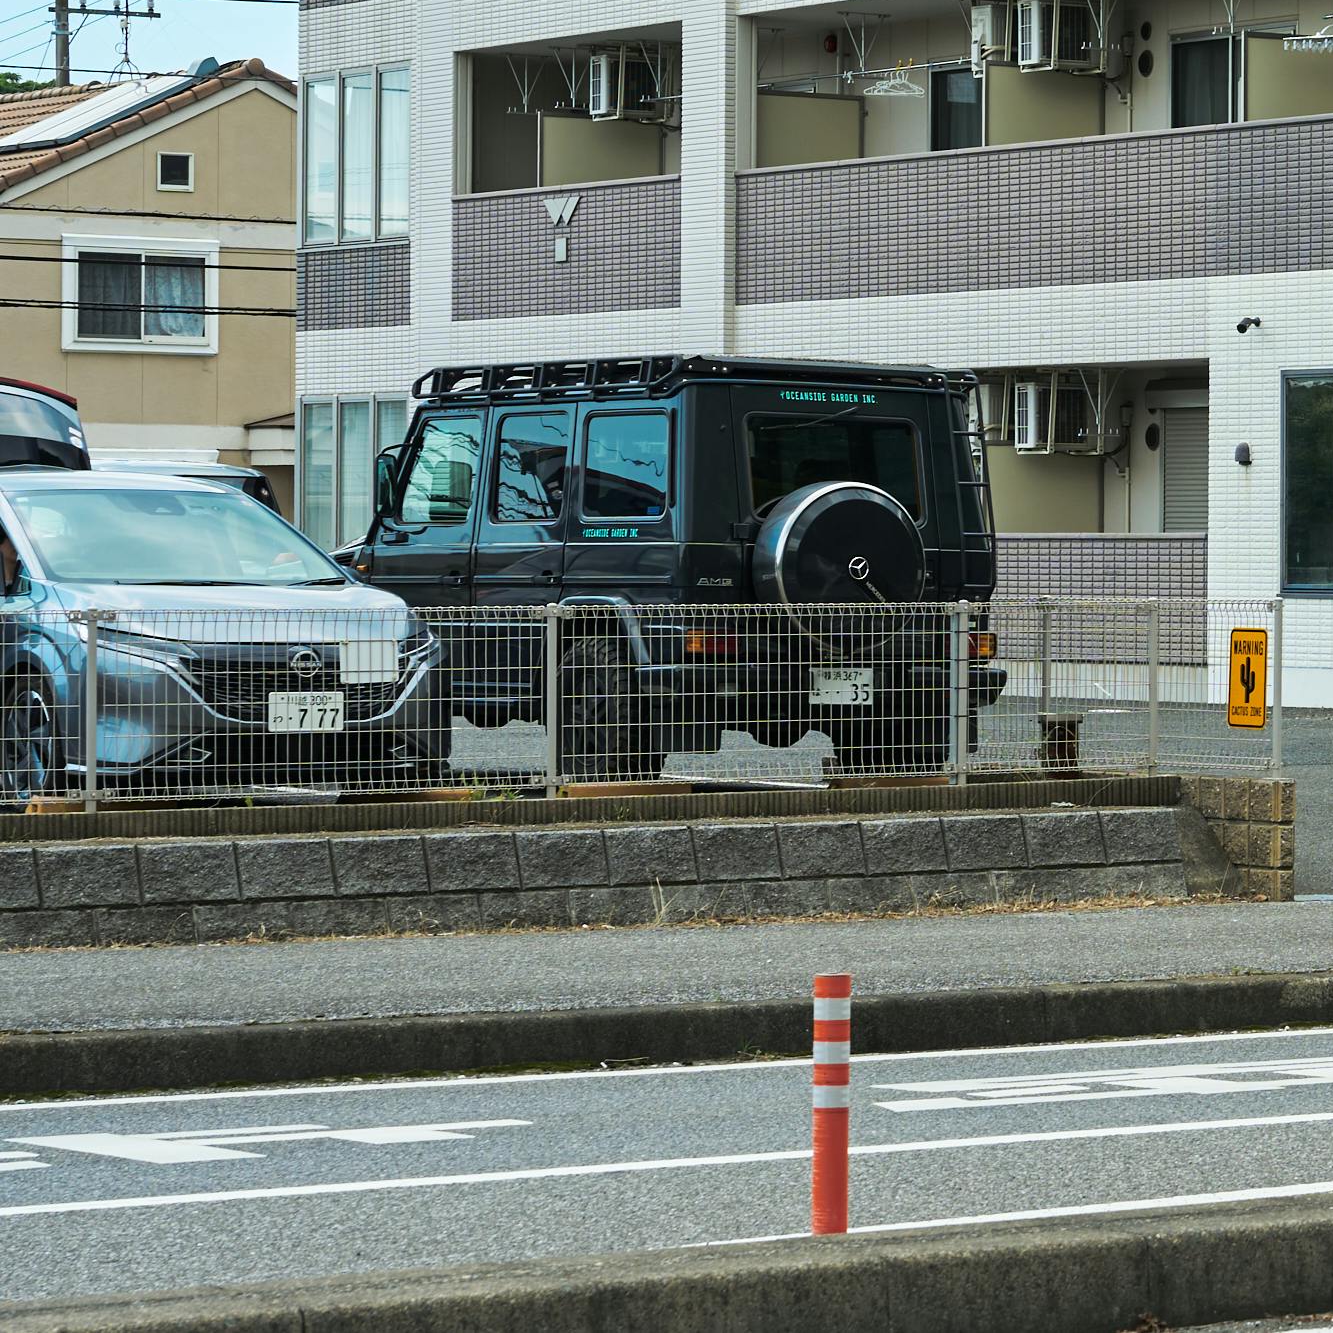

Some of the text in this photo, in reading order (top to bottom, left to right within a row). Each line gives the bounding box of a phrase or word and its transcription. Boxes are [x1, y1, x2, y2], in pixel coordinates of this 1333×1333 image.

[785, 391, 826, 402] OCEANSIDE
[831, 393, 858, 403] GARDEN
[696, 578, 733, 587] AMG
[1234, 640, 1264, 656] WARNING
[1231, 706, 1262, 717] CACTUS ZONE
